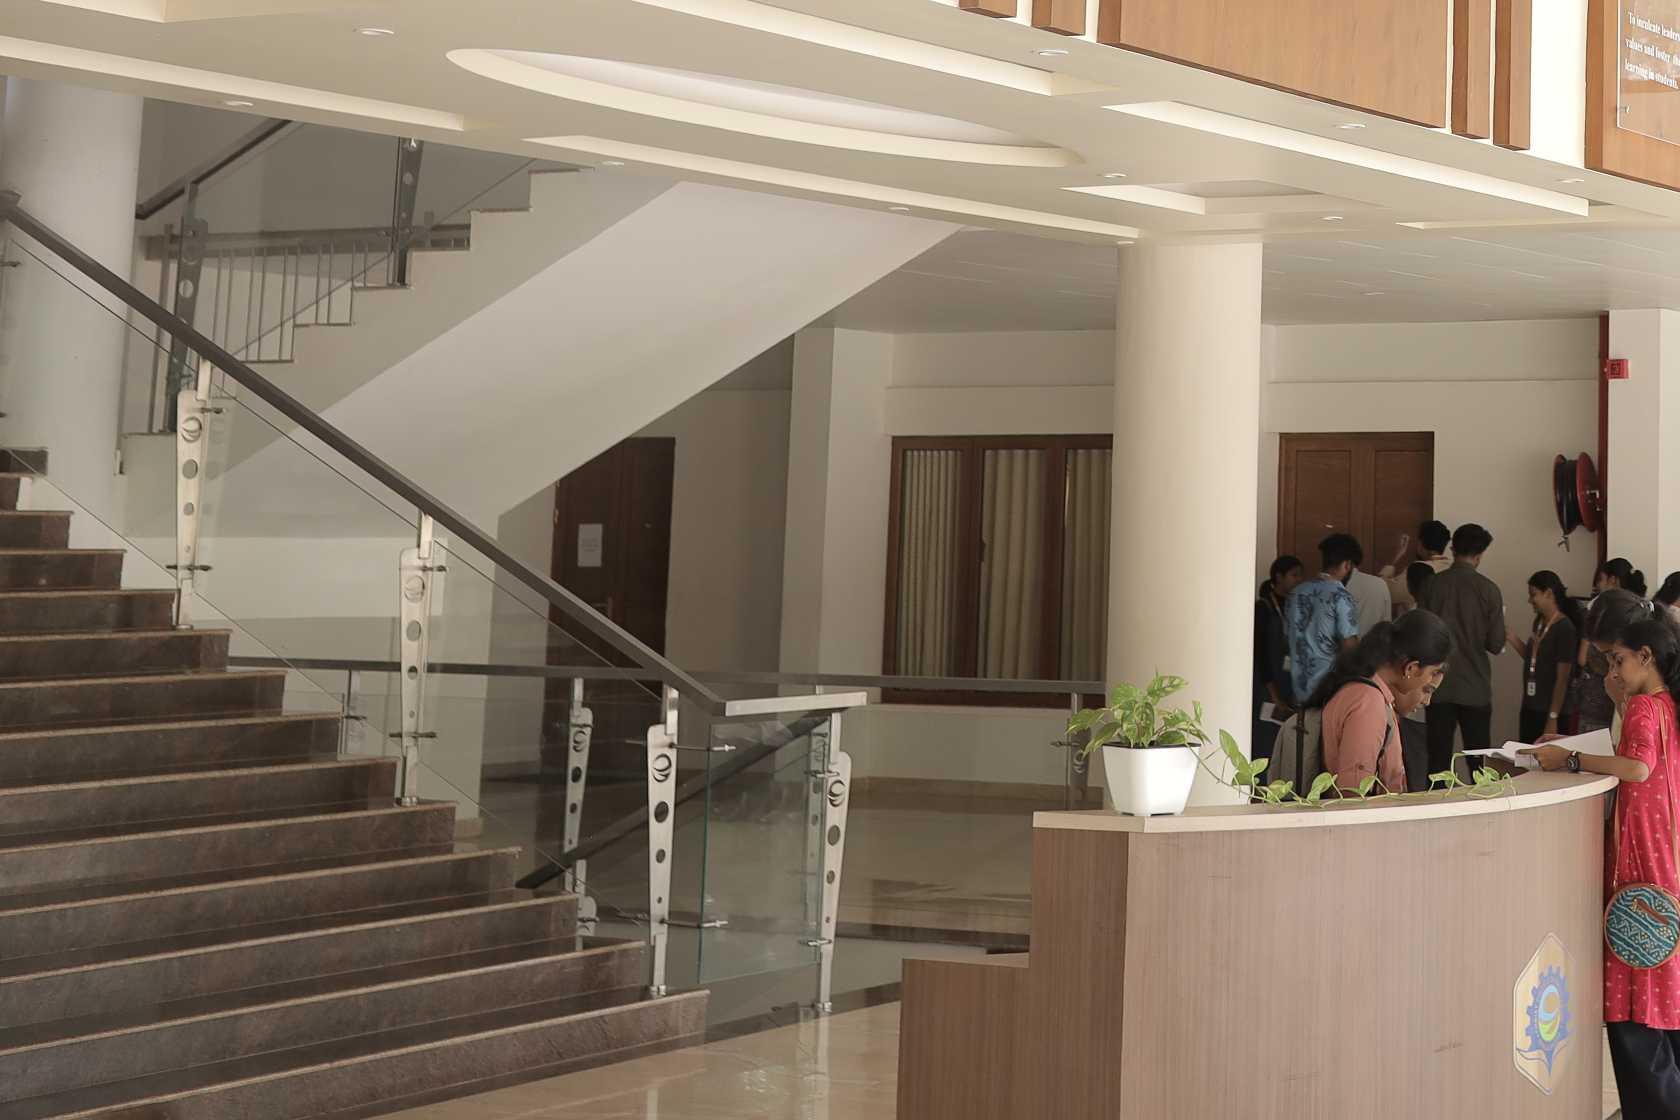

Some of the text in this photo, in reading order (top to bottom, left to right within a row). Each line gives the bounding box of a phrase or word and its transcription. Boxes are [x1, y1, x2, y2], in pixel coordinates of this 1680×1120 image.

[1625, 36, 1643, 51] values
[1643, 42, 1654, 57] and
[1624, 58, 1648, 80] learning
